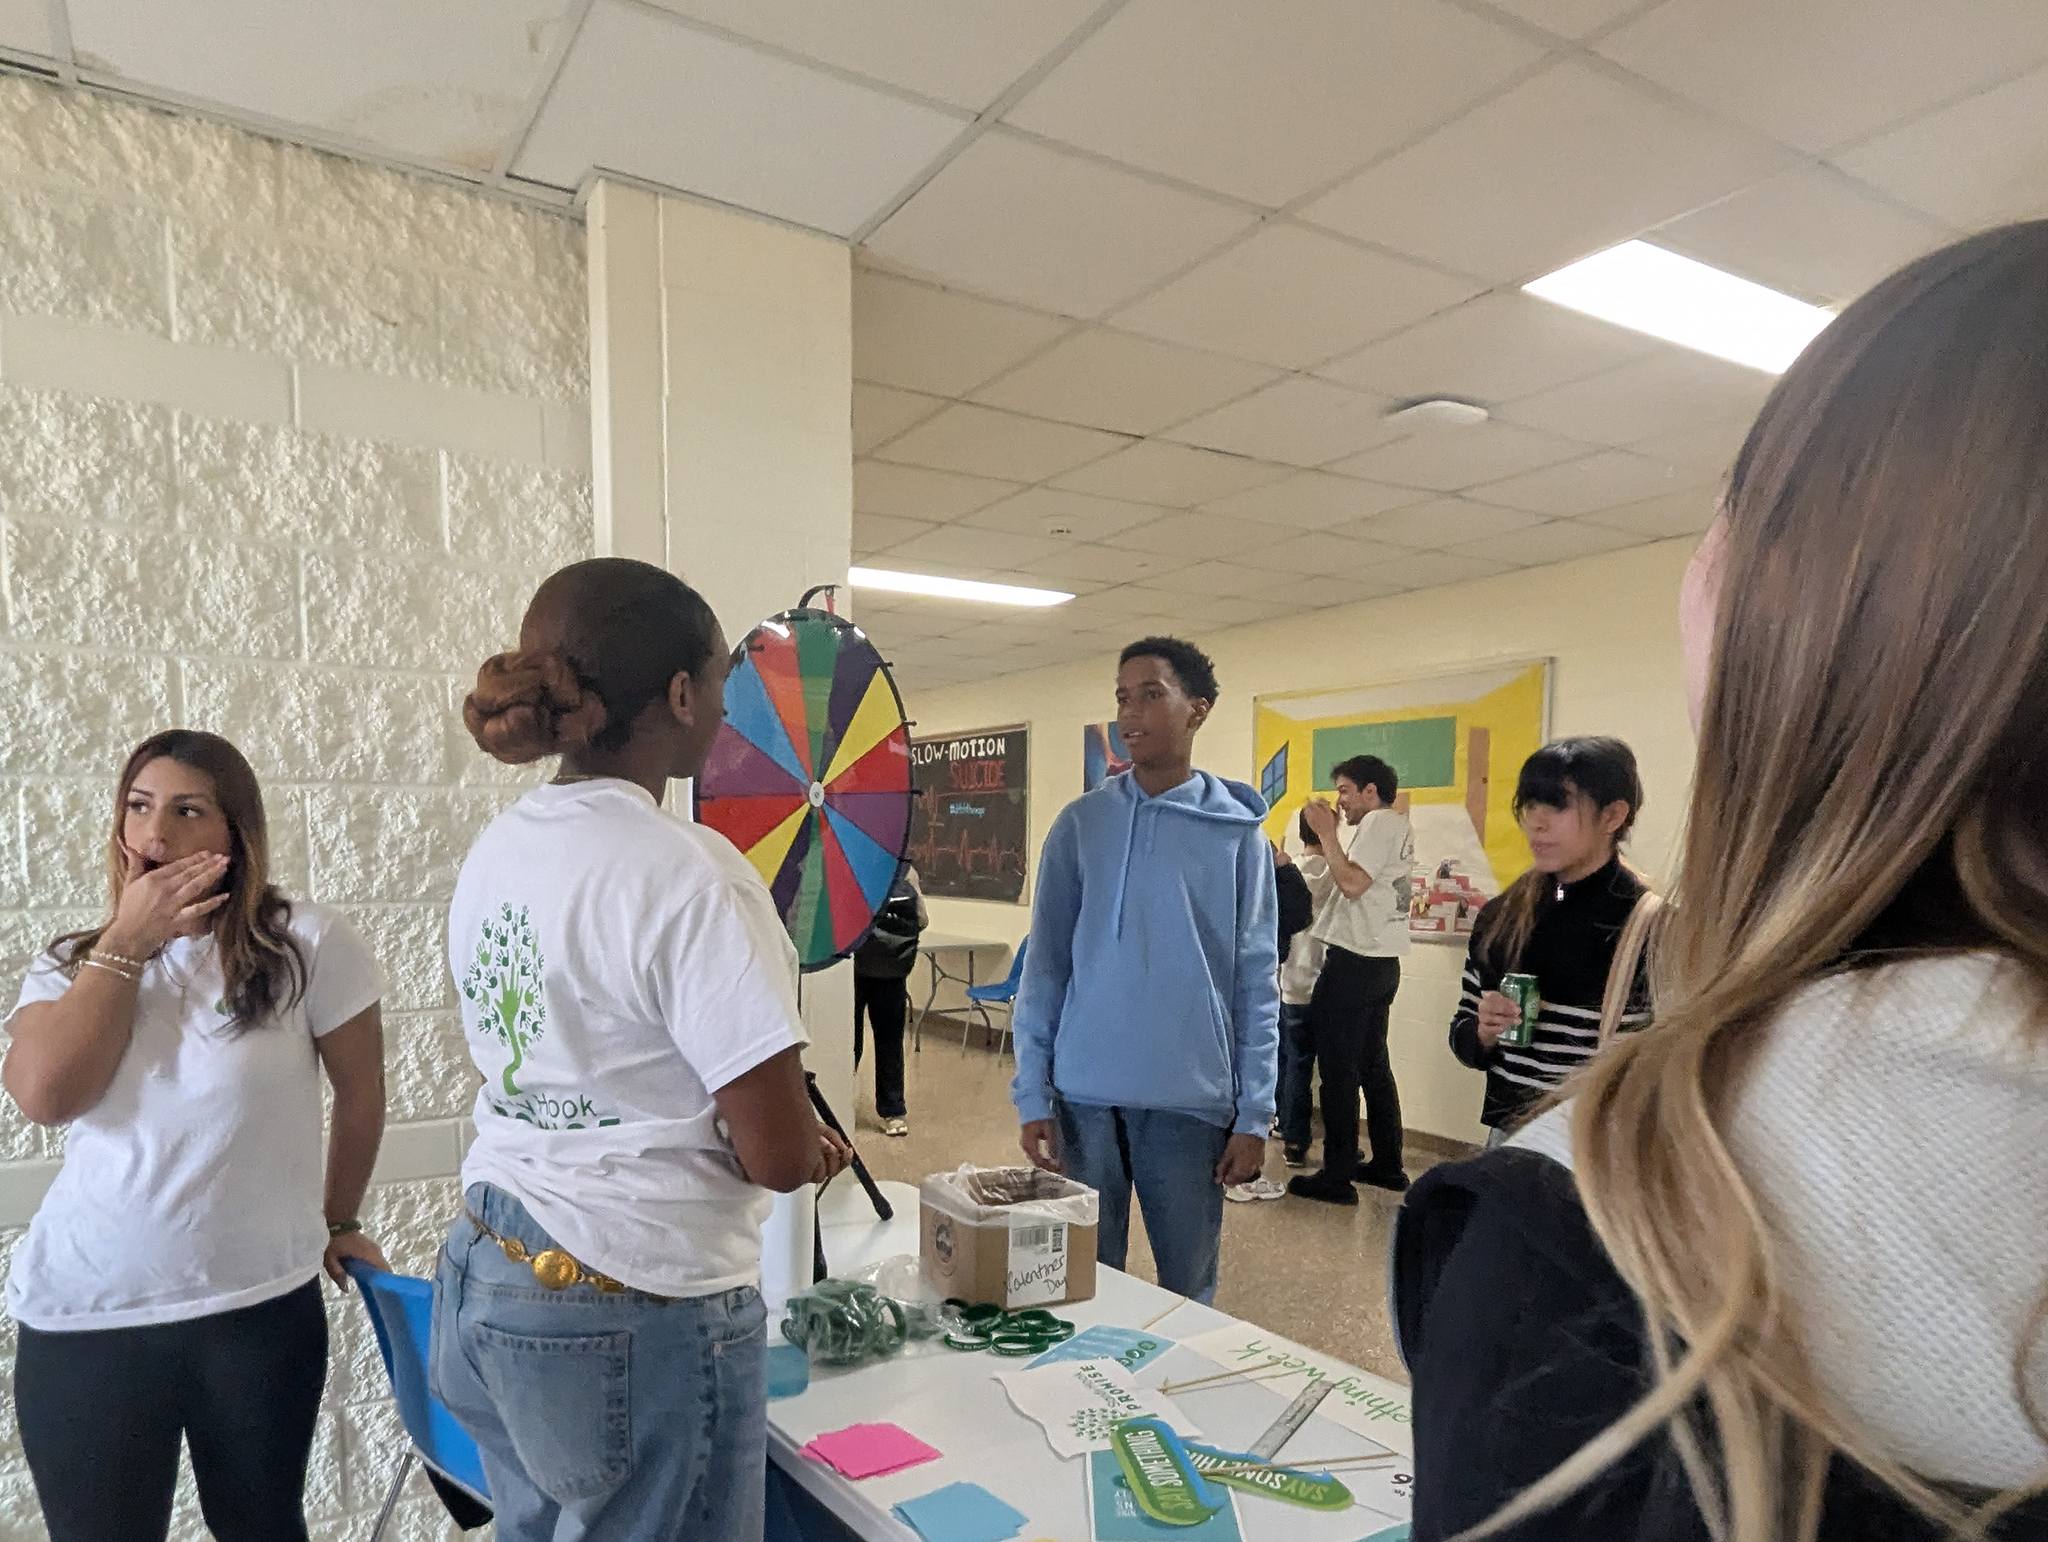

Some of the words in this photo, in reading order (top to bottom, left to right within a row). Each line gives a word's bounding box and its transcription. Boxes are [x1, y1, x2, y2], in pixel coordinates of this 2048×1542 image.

[532, 1092, 597, 1119] Hook
[1043, 1277, 1070, 1295] Day
[1080, 1364, 1142, 1410] PROMISE
[1124, 1429, 1184, 1488] SOMETHING
[1285, 1479, 1330, 1501] SAY
